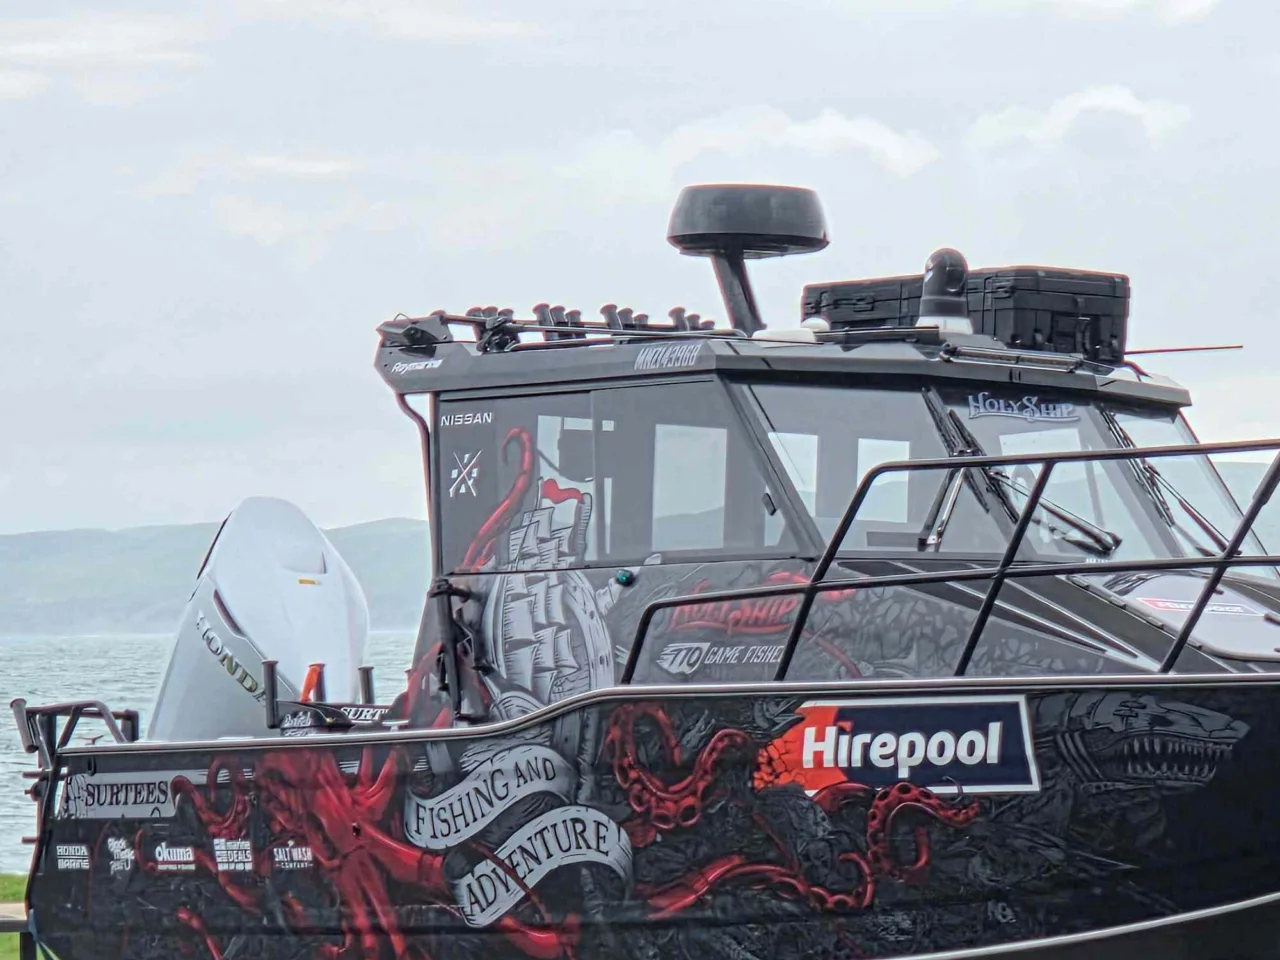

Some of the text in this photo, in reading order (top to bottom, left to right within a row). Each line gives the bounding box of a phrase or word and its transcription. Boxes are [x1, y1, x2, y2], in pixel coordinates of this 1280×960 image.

[440, 412, 492, 427] NISSAN
[704, 645, 746, 665] GAME
[741, 645, 786, 664] FISHE
[340, 706, 389, 721] SURT
[802, 721, 1004, 779] Hirepool
[85, 780, 169, 807] SURTEES
[414, 756, 557, 840] FISHING AND
[155, 842, 194, 861] okuma
[227, 851, 252, 862] DEALS
[273, 848, 313, 861] SALT WASH
[464, 817, 611, 916] ADVENTURE
